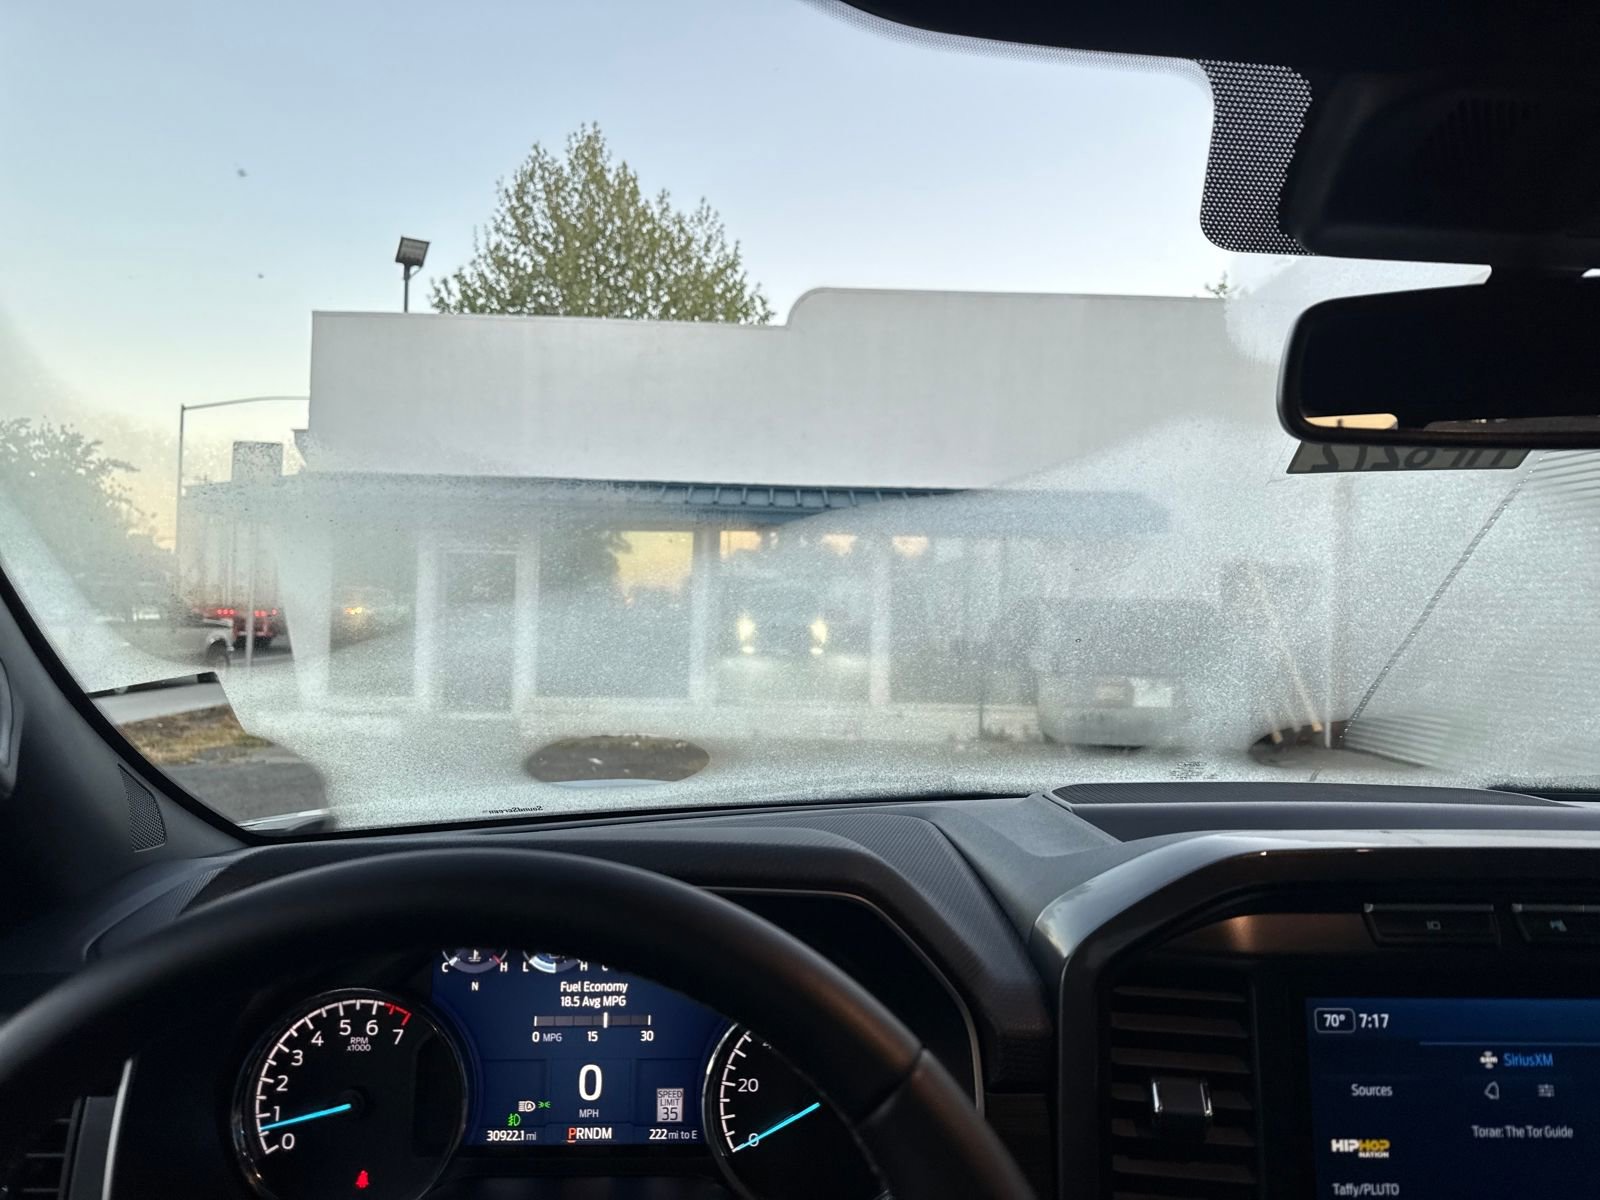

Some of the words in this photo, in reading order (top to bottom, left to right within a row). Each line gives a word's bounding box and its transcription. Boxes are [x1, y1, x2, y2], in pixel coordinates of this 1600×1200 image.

[441, 962, 449, 972] C
[500, 962, 508, 972] H
[522, 960, 530, 972] L
[580, 961, 588, 972] H
[472, 982, 478, 990] N
[560, 980, 582, 992] Fuel
[584, 980, 628, 994] Economy
[560, 996, 580, 1008] 18.5
[582, 996, 600, 1008] Avg
[602, 996, 626, 1006] MPG
[1358, 1014, 1388, 1028] 7:17
[340, 1020, 352, 1036] 5
[366, 1020, 378, 1036] 6
[310, 1030, 324, 1046] 4
[350, 1036, 370, 1046] RPM
[392, 1028, 404, 1044] 7
[532, 1032, 540, 1042] 0
[542, 1032, 562, 1042] MPG
[588, 1030, 598, 1042] 15
[640, 1030, 654, 1042] 30
[346, 1042, 372, 1052] x1000
[290, 1050, 304, 1066] 3
[1504, 1054, 1554, 1066] SiriusXM
[276, 1074, 288, 1092] 2
[578, 1064, 602, 1100] 0
[738, 1078, 758, 1092] 20
[657, 1090, 682, 1099] SPEED
[1352, 1084, 1392, 1096] Sources
[660, 1098, 680, 1106] LIMIT
[272, 1106, 280, 1122] 1
[578, 1108, 598, 1118] MPH
[662, 1106, 678, 1120] 35
[526, 1132, 536, 1140] mi
[648, 1128, 668, 1140] 222
[668, 1130, 678, 1140] mi
[680, 1130, 690, 1140] to
[692, 1130, 698, 1140] E
[1504, 1124, 1524, 1138] The
[1526, 1125, 1542, 1138] Tor
[1544, 1126, 1574, 1138] Guide
[282, 1132, 294, 1150] 0
